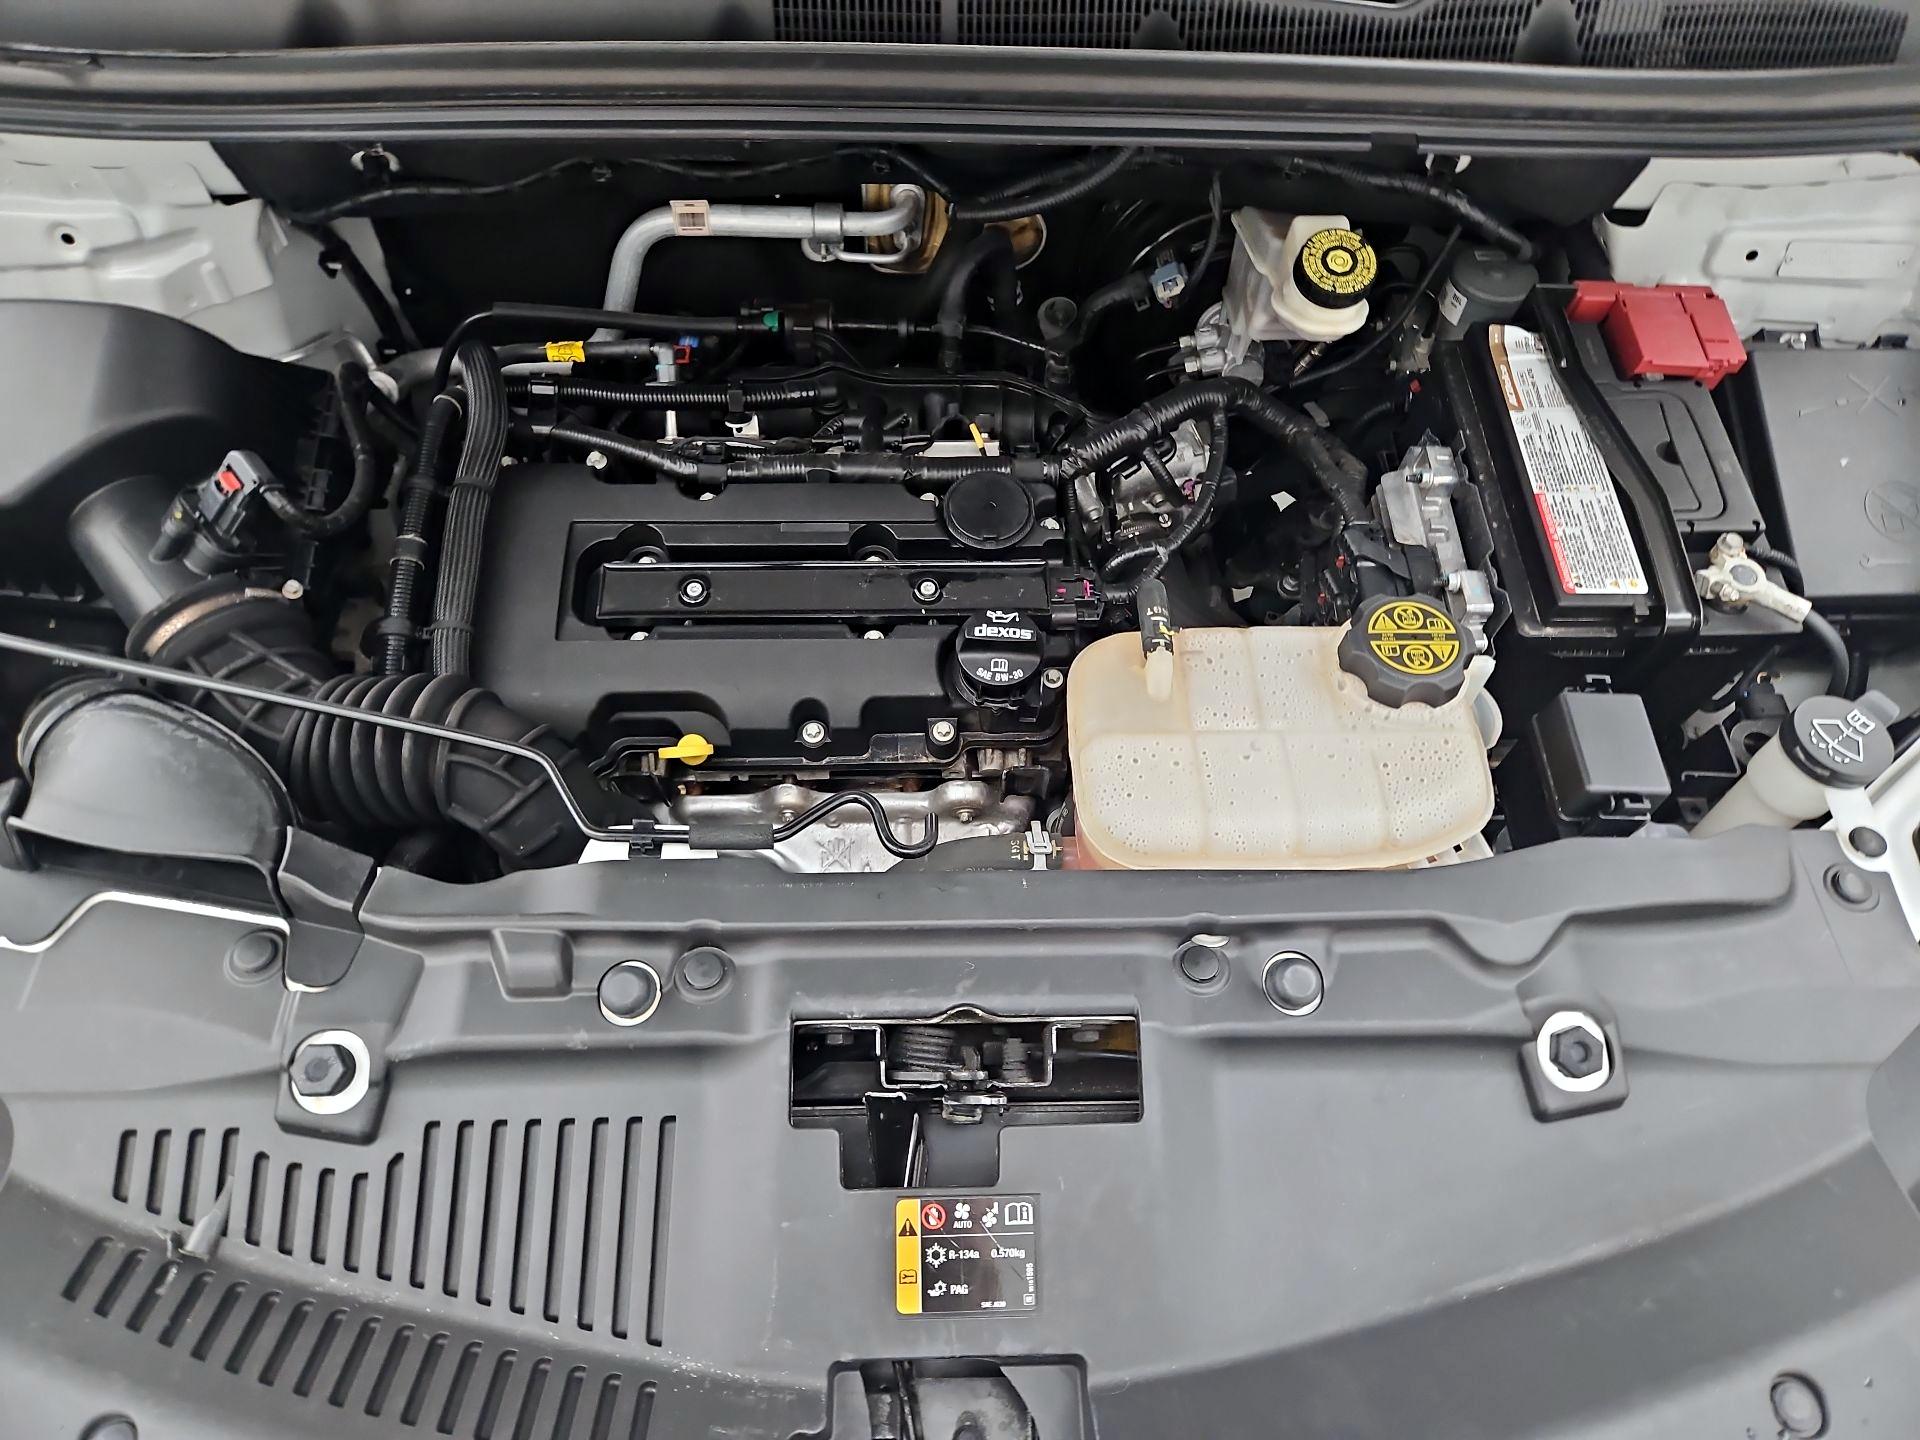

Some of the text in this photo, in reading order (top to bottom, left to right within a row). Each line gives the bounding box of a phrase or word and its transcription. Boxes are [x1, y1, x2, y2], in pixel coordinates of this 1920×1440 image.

[974, 624, 1033, 639] dexos
[976, 667, 993, 681] SAE
[948, 1248, 1026, 1259] R-134a 0.570kg
[950, 1284, 969, 1295] PAG
